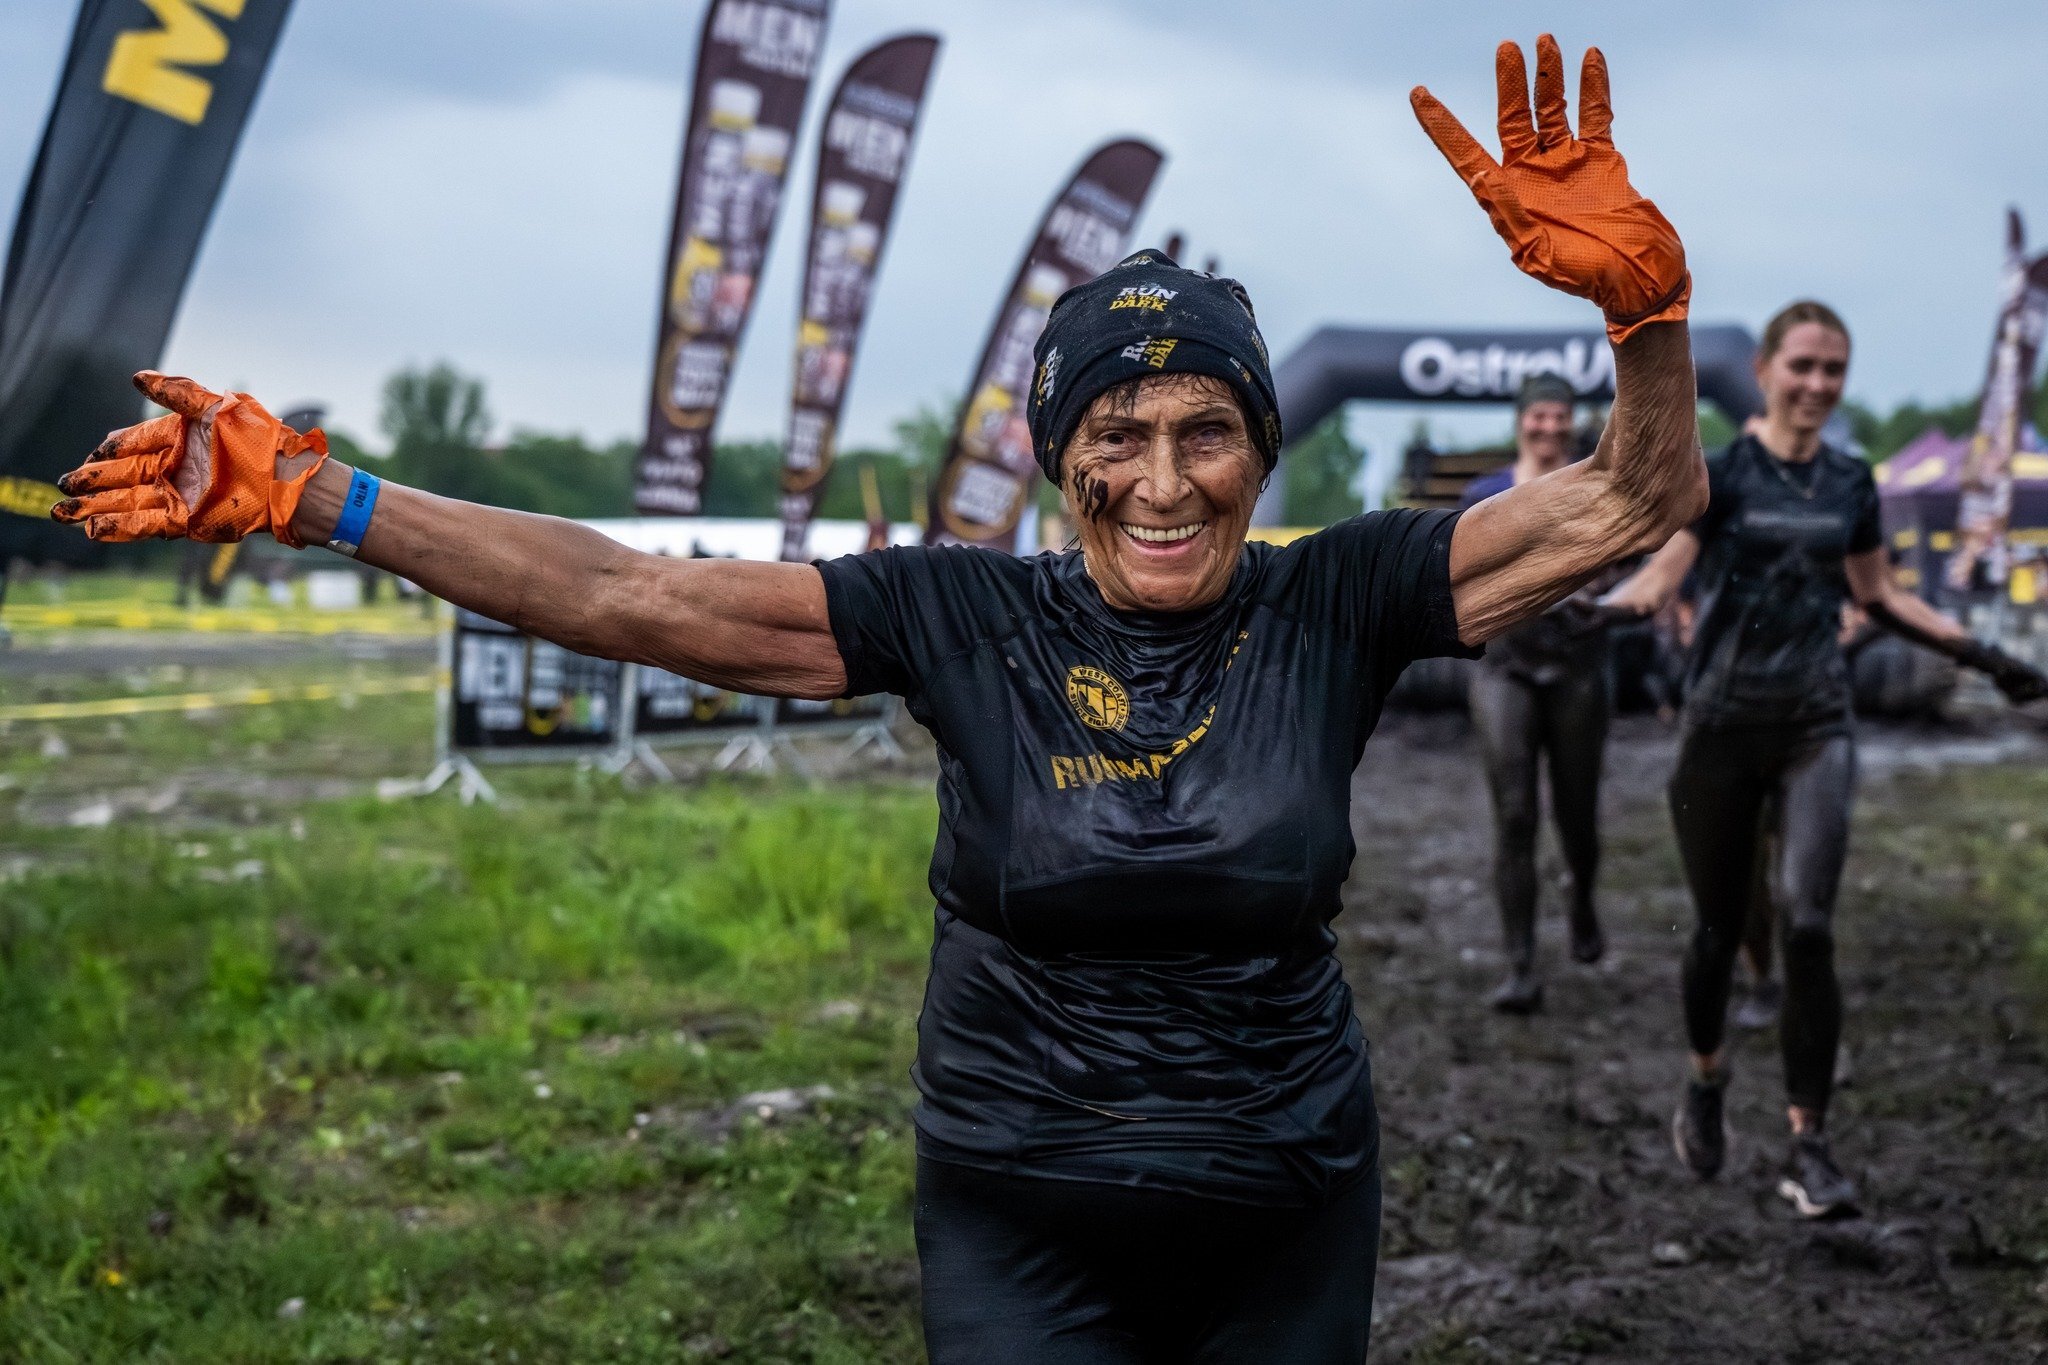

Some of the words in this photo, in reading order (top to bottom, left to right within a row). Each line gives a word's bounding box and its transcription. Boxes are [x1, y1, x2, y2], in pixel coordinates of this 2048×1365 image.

[1117, 287, 1179, 300] RUN
[1108, 299, 1168, 312] DARK
[1148, 338, 1179, 369] DAR
[352, 481, 369, 508] INTRO
[1079, 668, 1107, 681] WEST
[1070, 693, 1088, 720] SINCE
[1088, 717, 1111, 727] EIGH
